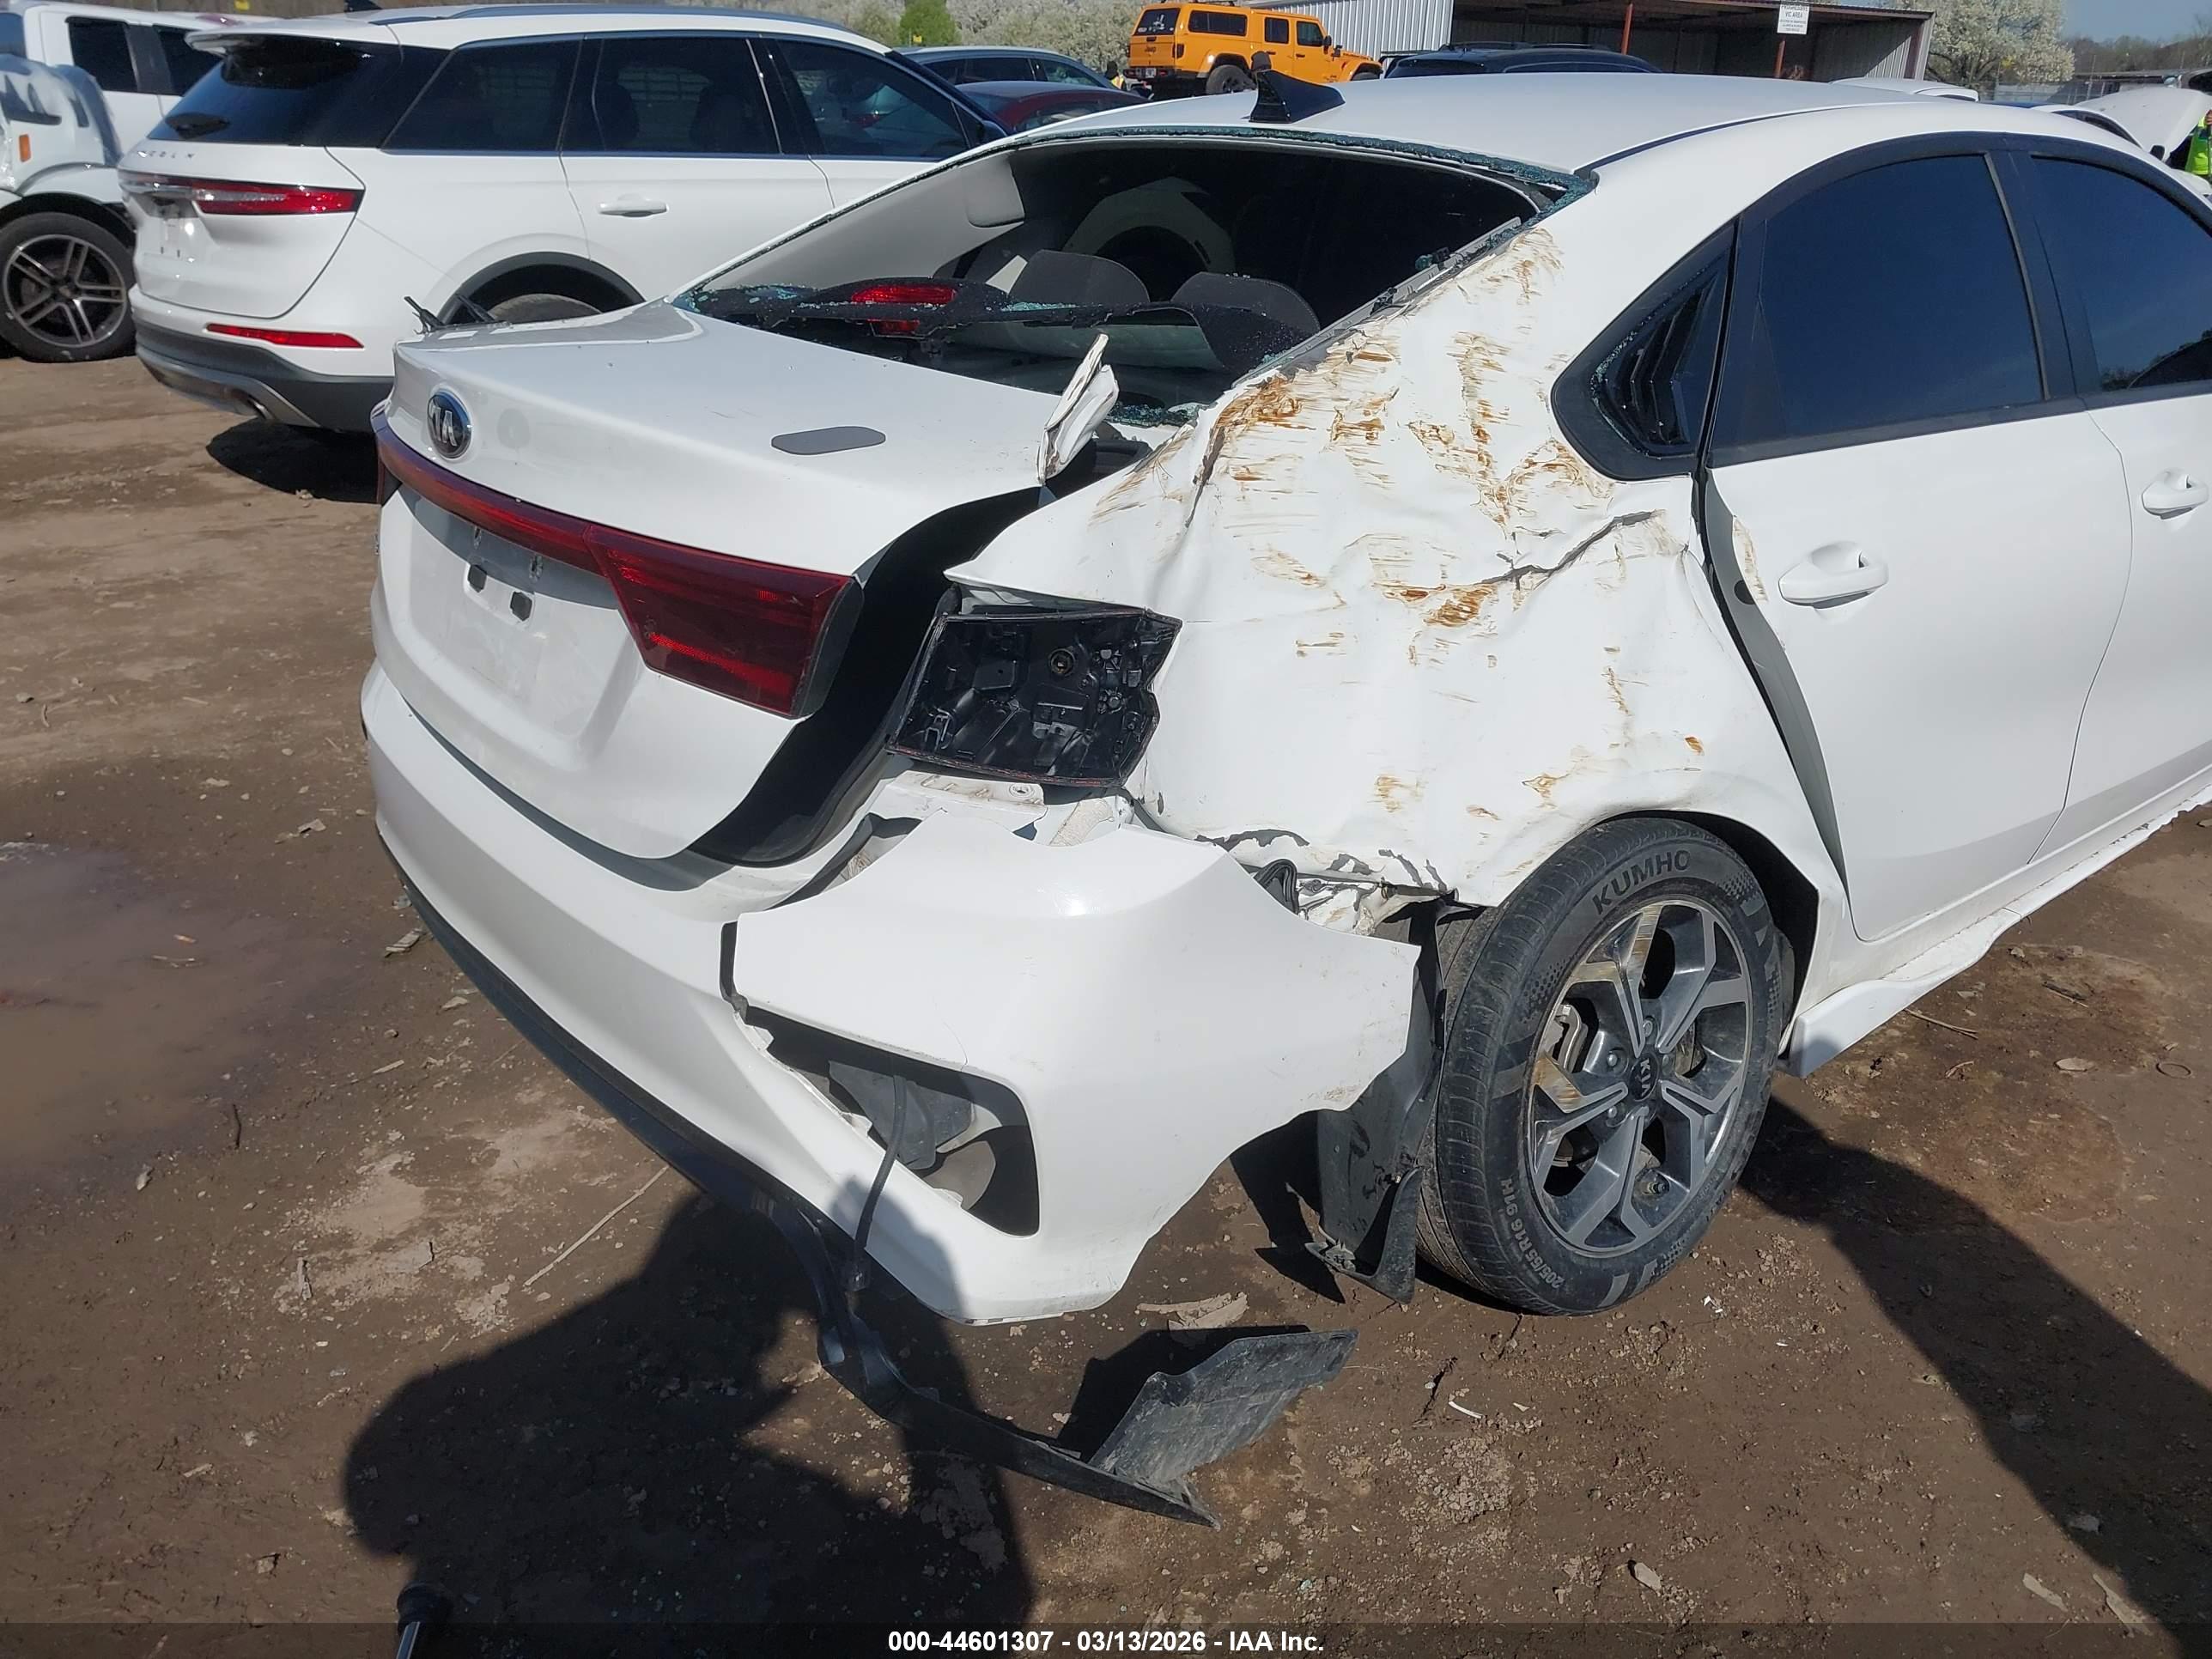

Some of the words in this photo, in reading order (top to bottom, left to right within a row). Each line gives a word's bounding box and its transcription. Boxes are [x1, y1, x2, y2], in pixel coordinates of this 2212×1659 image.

[1592, 849, 1691, 915] KUMHO
[1640, 1058, 1651, 1097] KIA
[1500, 1178, 1518, 1217] 91H
[1525, 1248, 1565, 1289] 205/55
